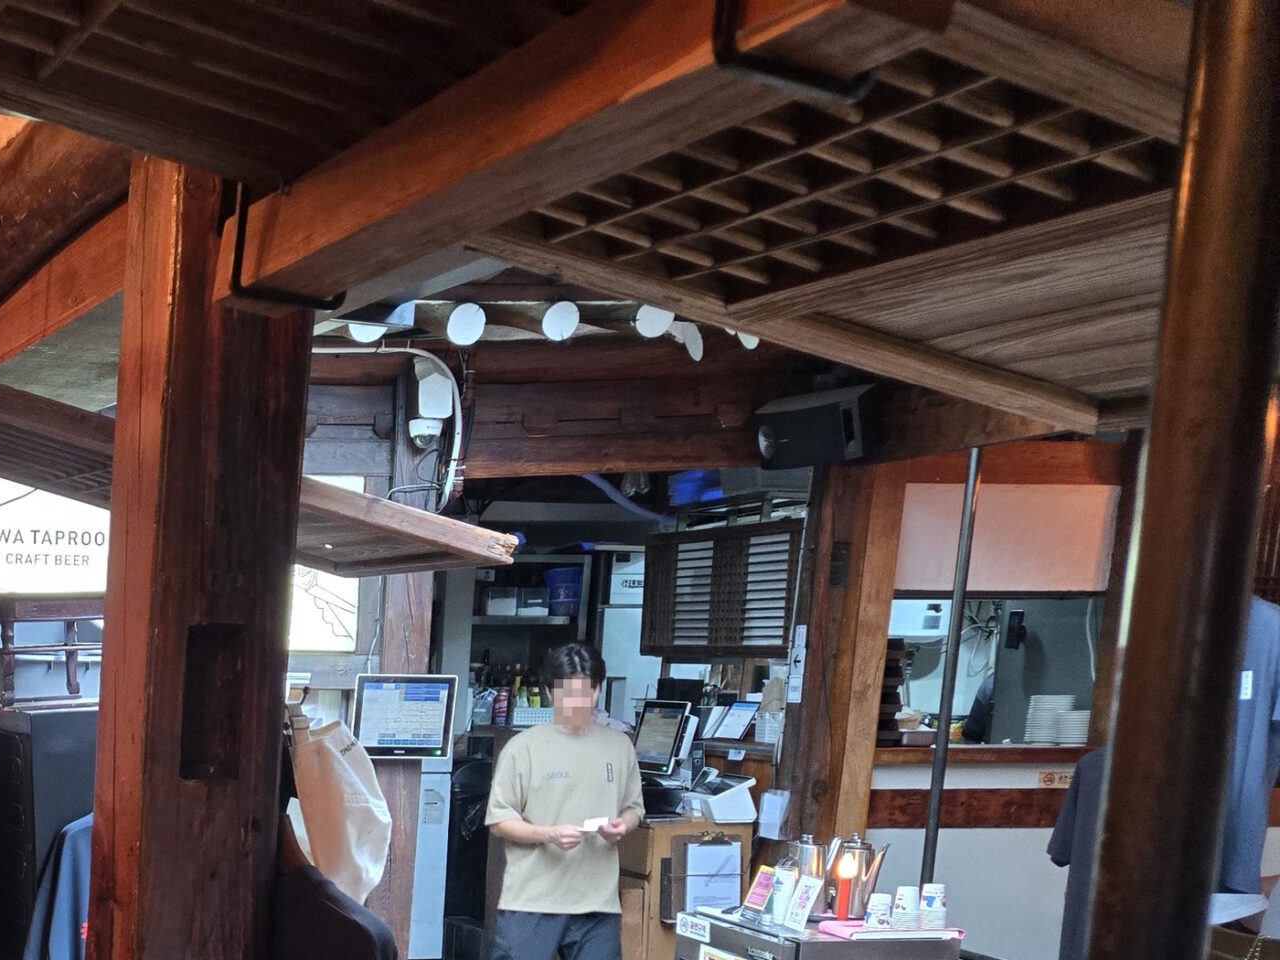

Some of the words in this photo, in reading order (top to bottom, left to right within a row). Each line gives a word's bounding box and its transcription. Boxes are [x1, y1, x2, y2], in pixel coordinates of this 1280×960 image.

[30, 529, 106, 547] TAPROO
[5, 553, 50, 566] CRAFT
[54, 554, 90, 567] BEER
